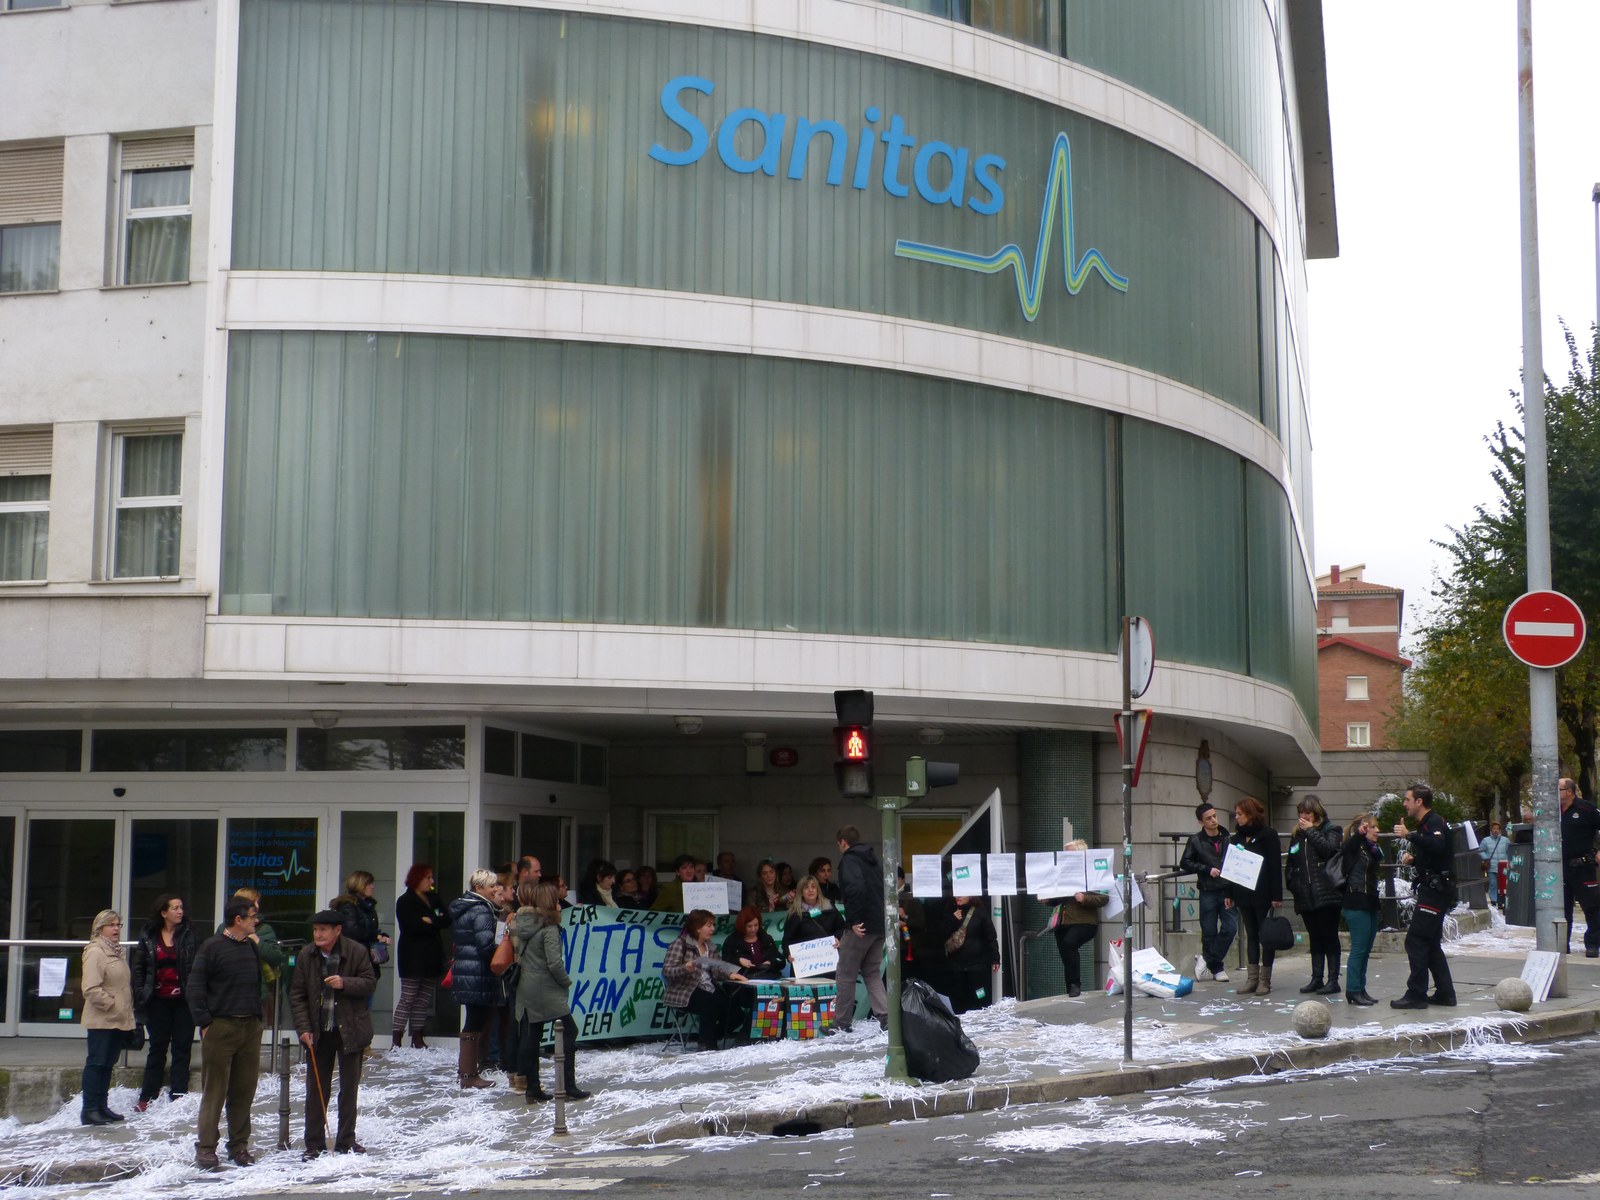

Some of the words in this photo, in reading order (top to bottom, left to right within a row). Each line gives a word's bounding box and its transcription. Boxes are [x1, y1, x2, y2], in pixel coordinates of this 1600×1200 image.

[648, 75, 1007, 215] Sanitas
[228, 852, 284, 867] Sanitas
[1094, 859, 1107, 867] ELA
[569, 904, 598, 926] ELA
[615, 909, 659, 925] ELA
[757, 984, 782, 996] ELA
[788, 985, 814, 997] ELA
[541, 1021, 555, 1043] EL
[582, 1012, 613, 1036] ELA
